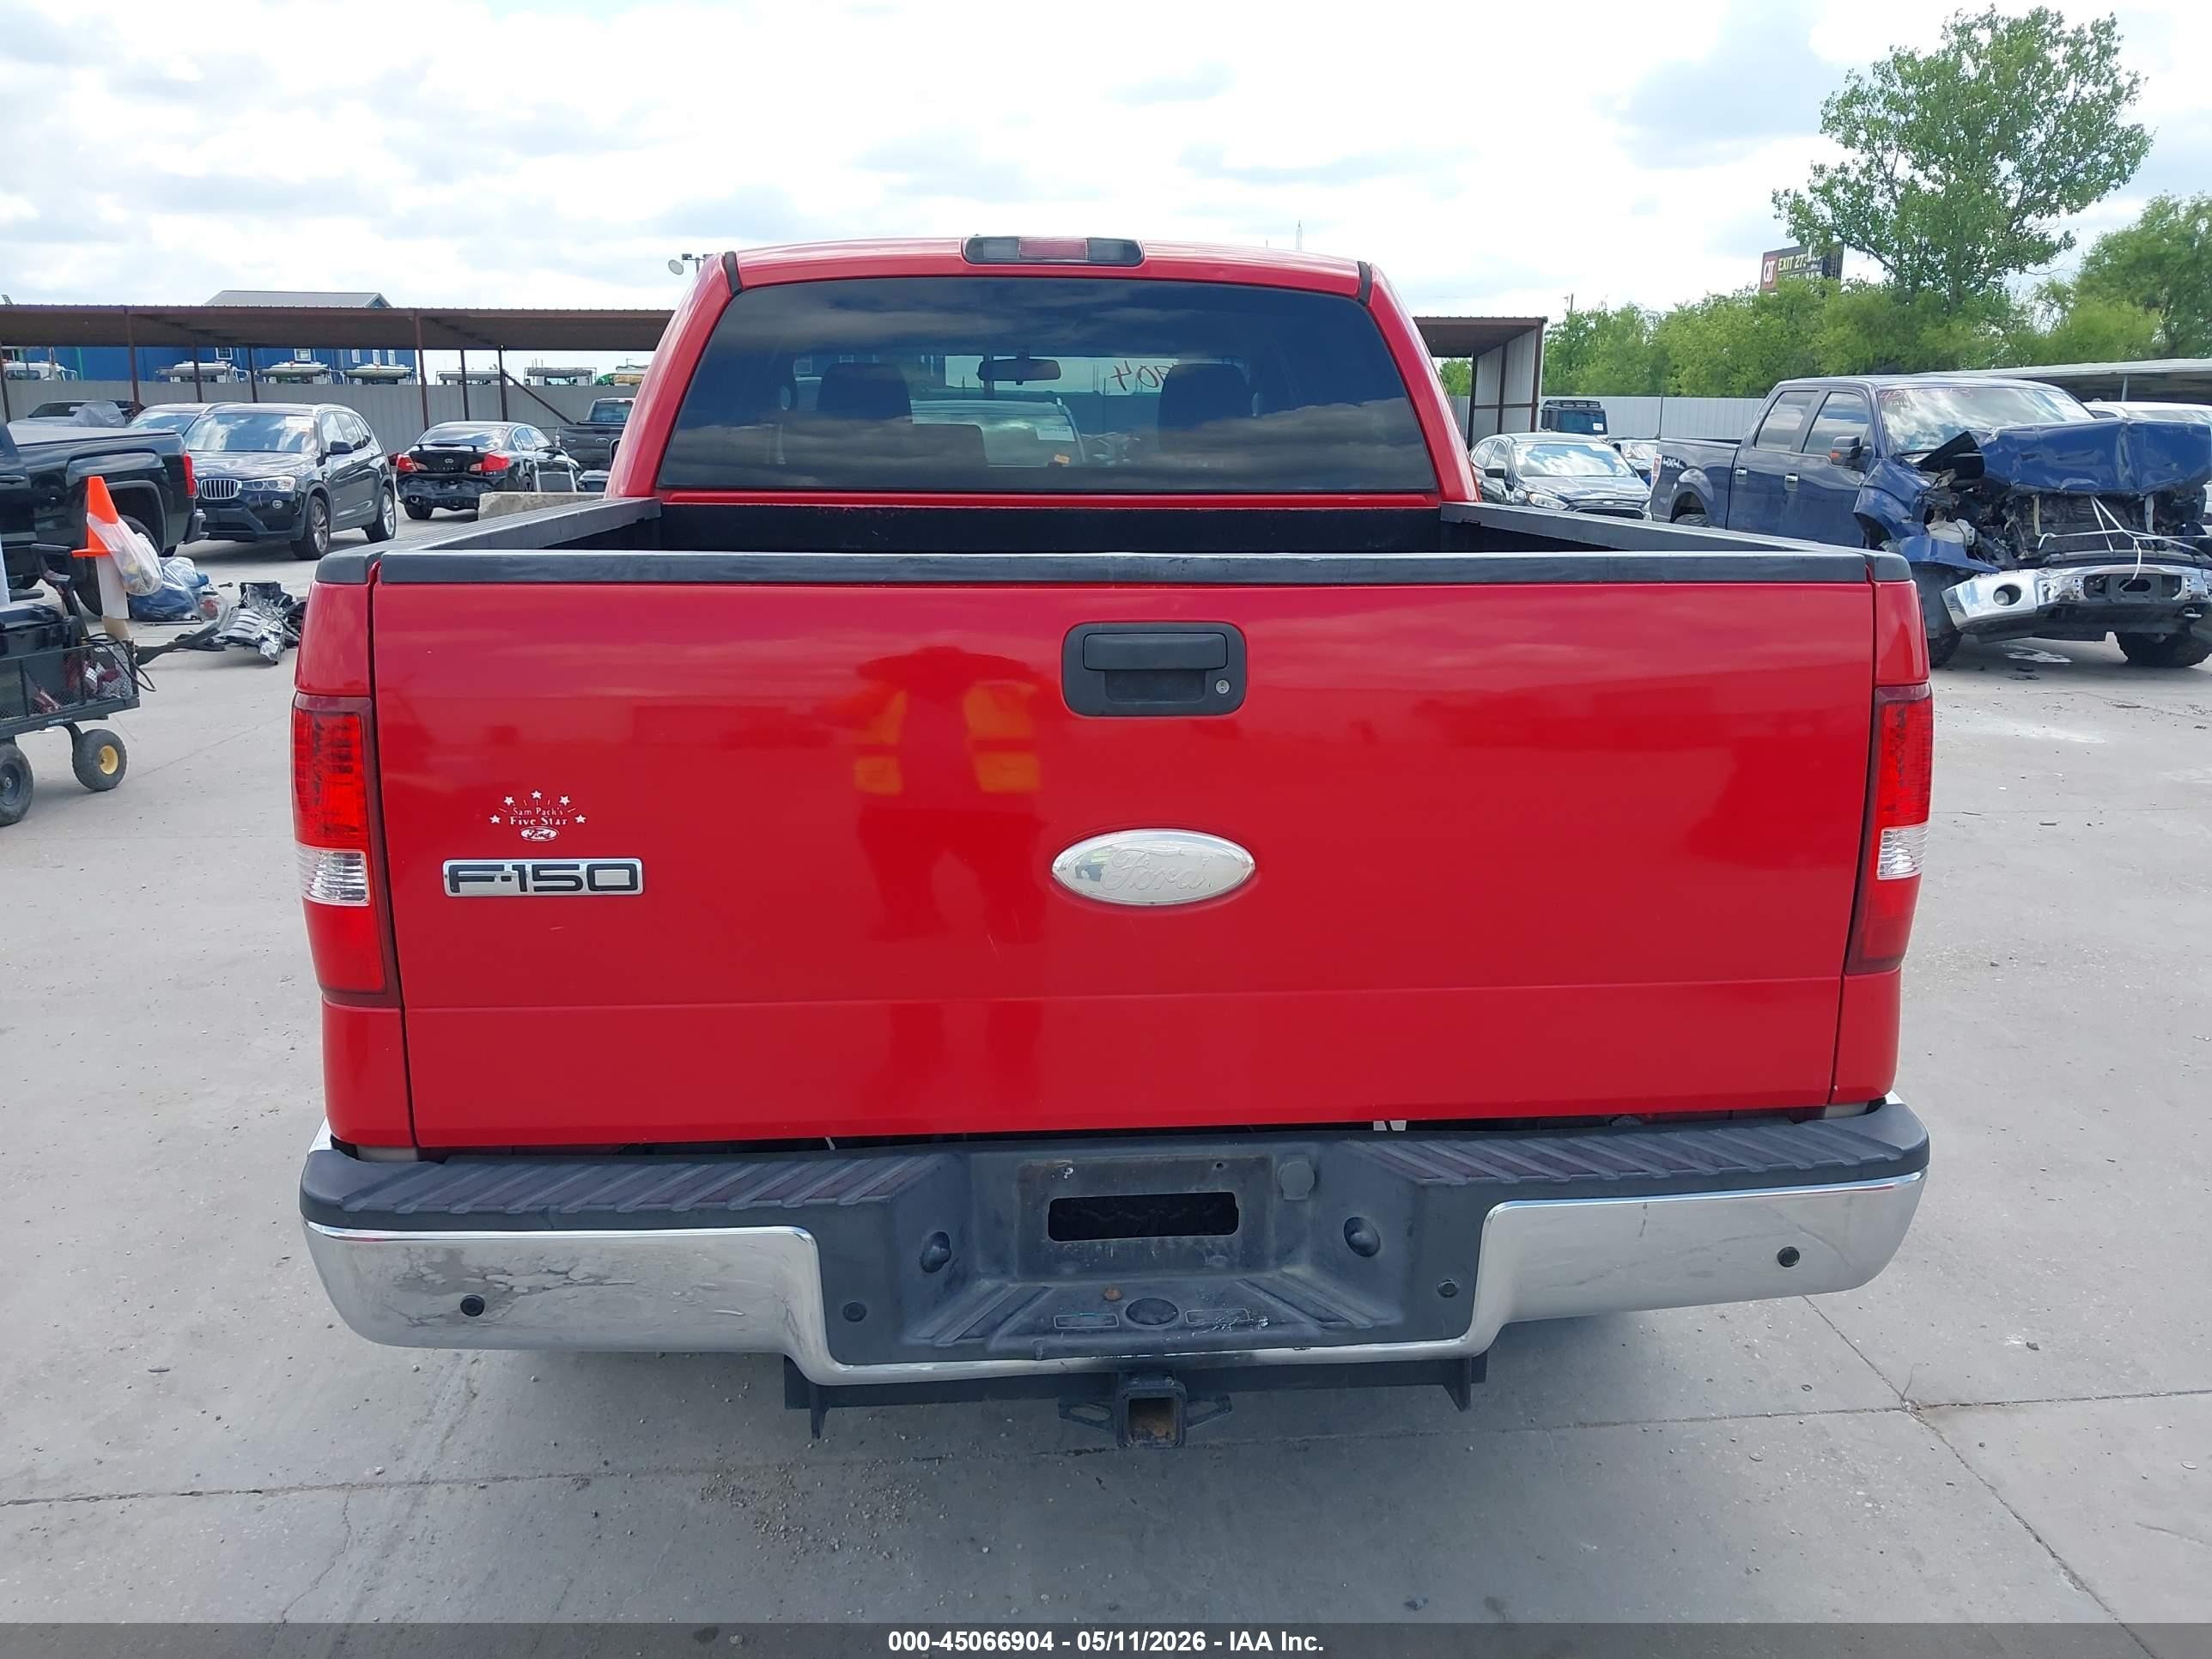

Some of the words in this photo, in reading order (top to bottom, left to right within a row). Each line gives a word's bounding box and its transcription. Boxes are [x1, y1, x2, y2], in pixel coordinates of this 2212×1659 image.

[1778, 255, 1795, 271] EXIT
[1795, 252, 1807, 270] 27
[513, 807, 532, 816] Sam
[536, 807, 563, 816] Pack's
[510, 817, 537, 825] Five
[541, 816, 568, 825] Star
[526, 829, 551, 839] Ford
[1101, 845, 1210, 890] Ford
[447, 863, 639, 893] F-150
